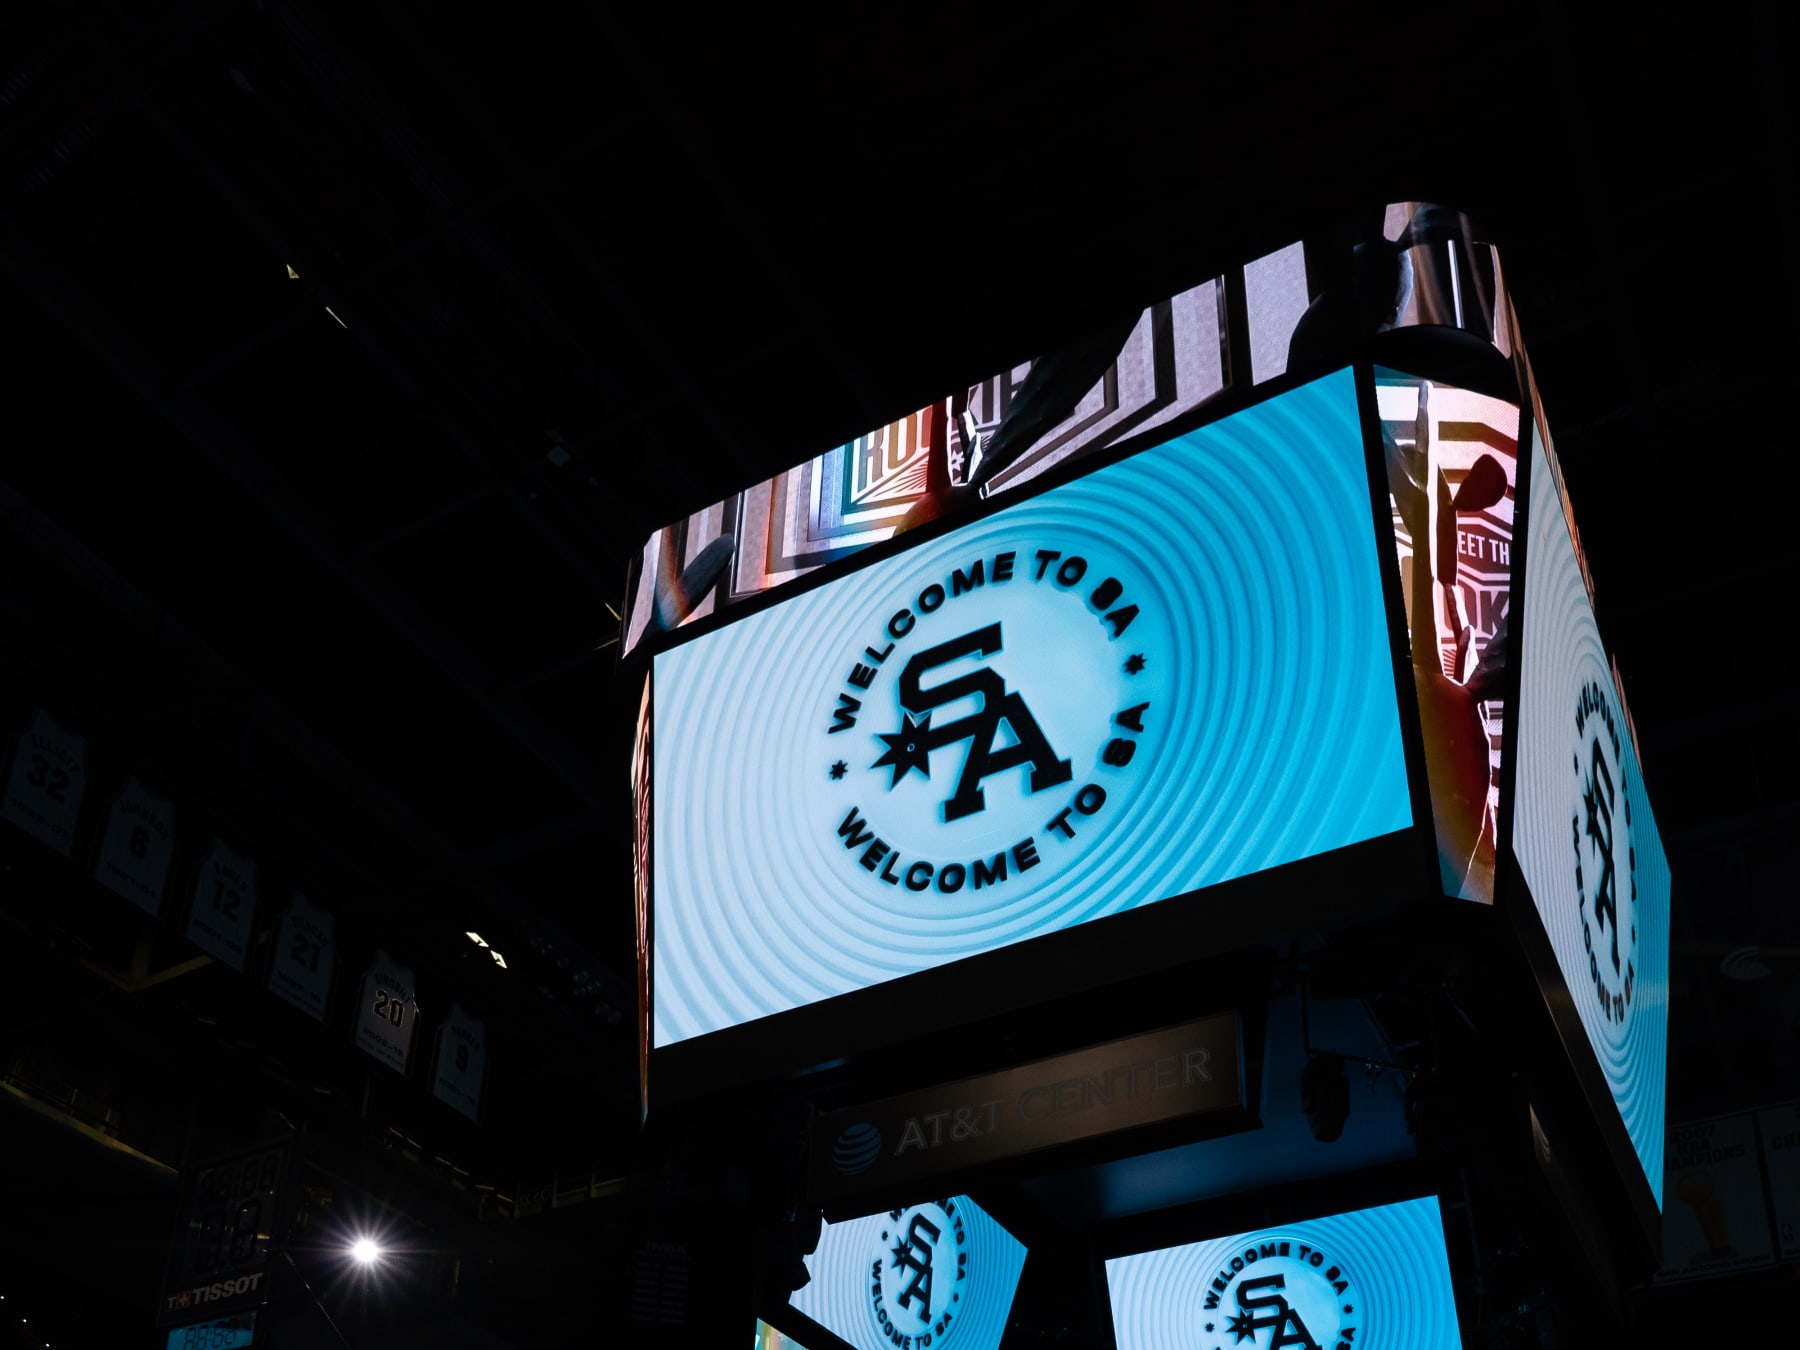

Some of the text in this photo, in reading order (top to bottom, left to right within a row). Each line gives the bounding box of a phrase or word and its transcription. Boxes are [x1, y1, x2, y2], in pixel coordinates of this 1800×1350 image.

[1458, 531, 1510, 566] EET TH
[828, 549, 1139, 734] WELCOME TO SA
[870, 621, 1072, 823] SA
[1575, 681, 1621, 766] WELCOME
[27, 754, 71, 803] 32
[837, 701, 1150, 893] WELCOME TO SA
[130, 826, 150, 859] 6
[212, 880, 242, 922] 12
[1573, 814, 1612, 1022] WELCOME
[1612, 995, 1625, 1026] TO
[291, 934, 320, 974] 21
[373, 989, 404, 1028] 20
[455, 1045, 469, 1072] 9
[894, 1047, 1212, 1156] AT&T CENTER
[1671, 1124, 1715, 1144] 2007
[1665, 1144, 1745, 1171] AMPIONS
[192, 1273, 263, 1305] TISSOT
[1203, 1242, 1348, 1309] WELCOME TO SA
[872, 1259, 911, 1350] WELCOME
[915, 1333, 932, 1350] TO
